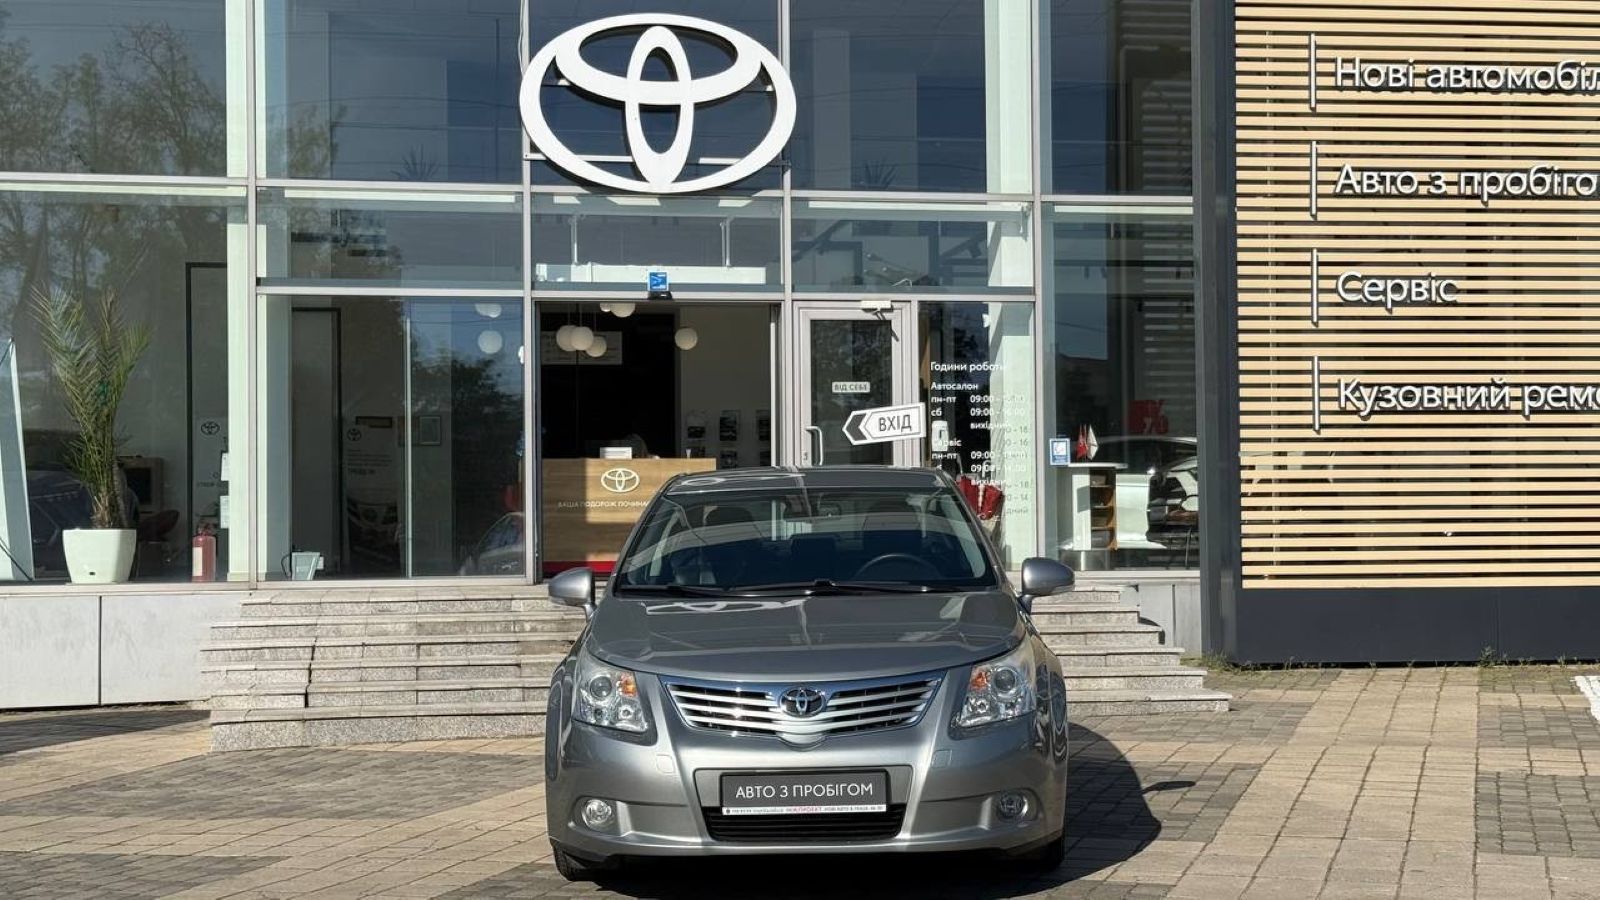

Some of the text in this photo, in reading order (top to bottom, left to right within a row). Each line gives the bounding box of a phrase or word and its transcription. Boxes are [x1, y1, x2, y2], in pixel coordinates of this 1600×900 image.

[1335, 57, 1415, 88] Нові
[1335, 164, 1598, 205] Авто з пробіго
[1336, 272, 1458, 310] Сервіс
[930, 361, 967, 372] Години
[930, 382, 978, 390] Автосалон
[1338, 377, 1600, 416] Кузовний рем
[931, 407, 942, 416] сб
[879, 414, 912, 432] ВХІД
[735, 785, 776, 799] АВТО
[793, 782, 873, 797] ПРОБІГОМ
